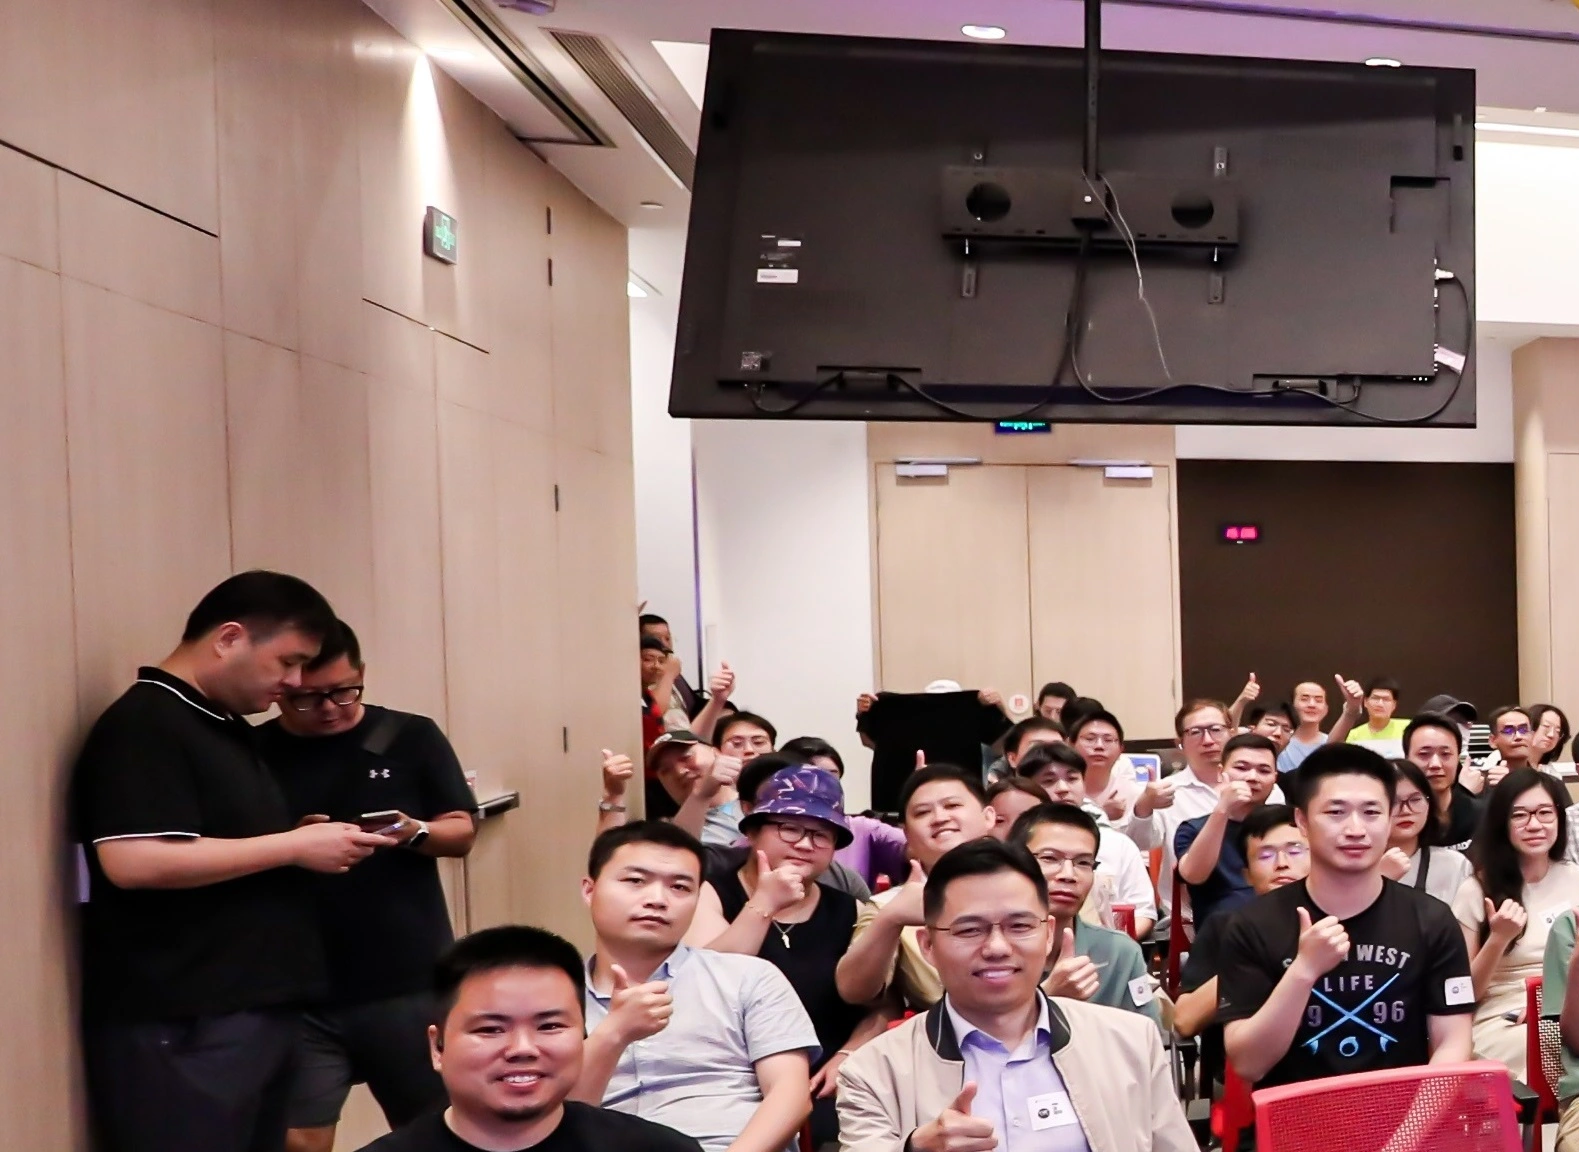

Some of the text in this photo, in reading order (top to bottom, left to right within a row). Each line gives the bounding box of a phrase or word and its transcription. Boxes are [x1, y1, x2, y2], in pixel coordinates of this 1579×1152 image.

[1356, 944, 1411, 969] WEST
[1324, 974, 1374, 993] LIFE
[1373, 1000, 1405, 1024] 96
